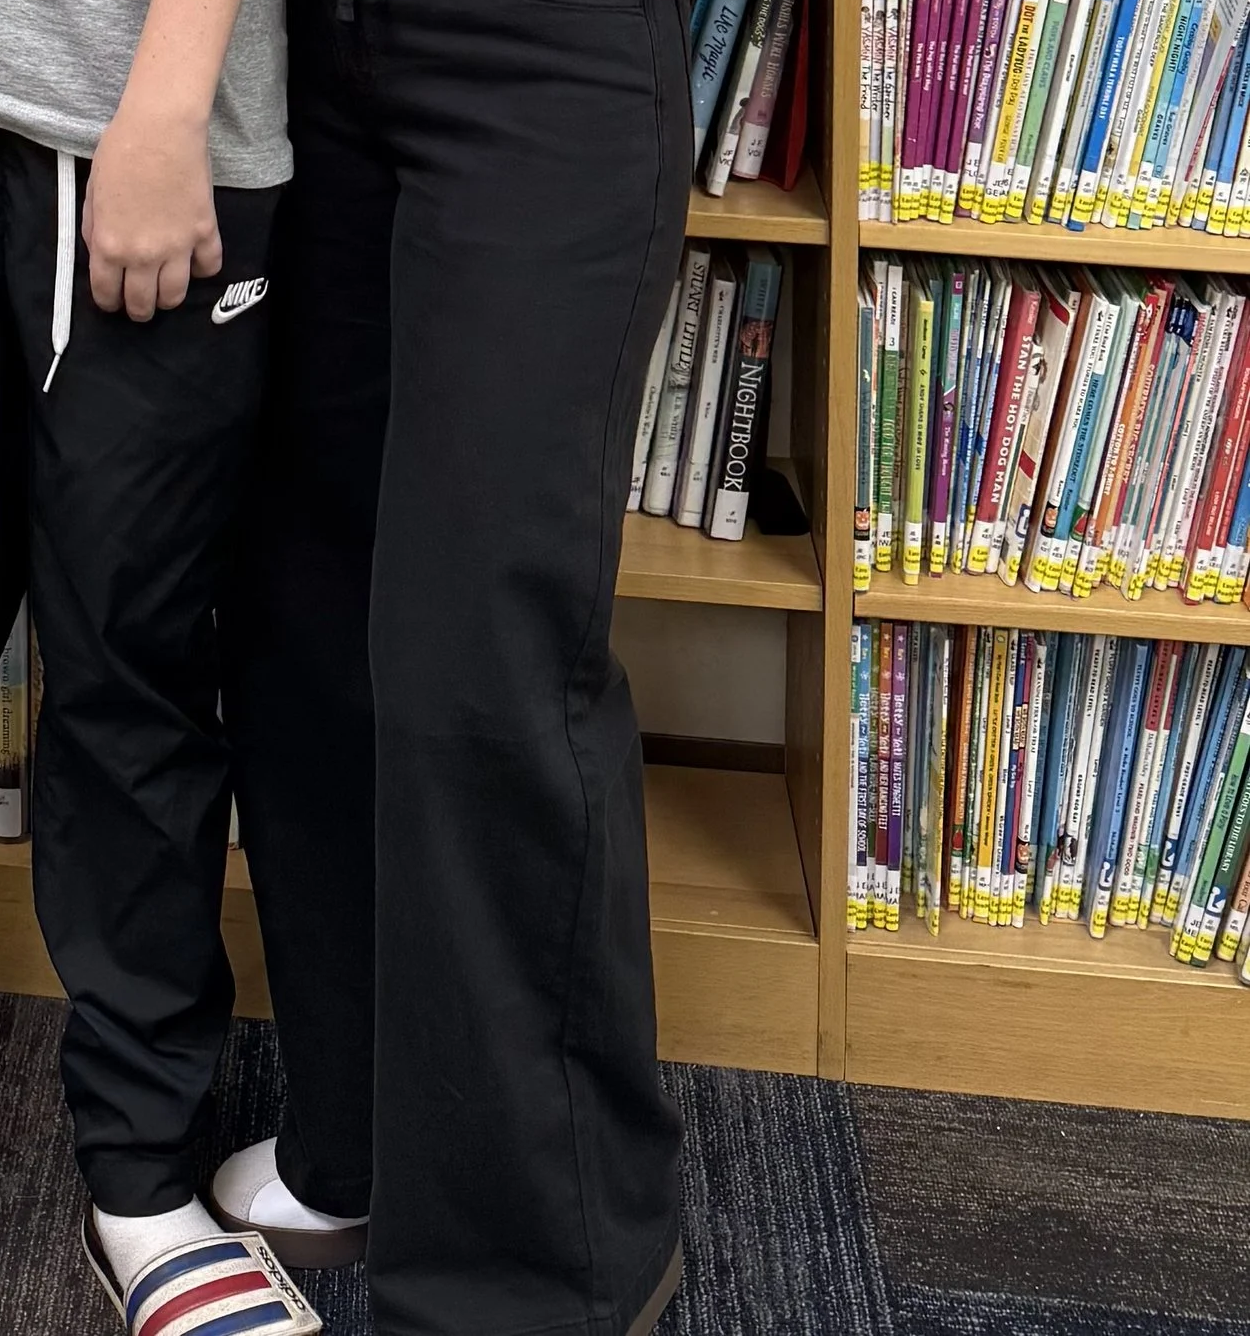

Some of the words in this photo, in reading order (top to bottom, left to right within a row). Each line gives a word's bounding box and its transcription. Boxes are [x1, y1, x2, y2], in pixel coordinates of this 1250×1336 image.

[1023, 5, 1037, 24] DOT
[220, 276, 266, 309] NIKE
[685, 261, 706, 317] STUART
[888, 337, 896, 347] 3
[1017, 334, 1033, 370] STAN
[1010, 375, 1025, 404] THE
[723, 362, 764, 491] NIGHTBOOK
[1005, 405, 1019, 433] HOT
[997, 436, 1012, 467] DOG
[990, 471, 1006, 504] MAN
[2, 647, 12, 686] brown
[1, 687, 13, 706] girl
[1, 707, 14, 755] dreaming
[257, 1245, 307, 1312] adidas
